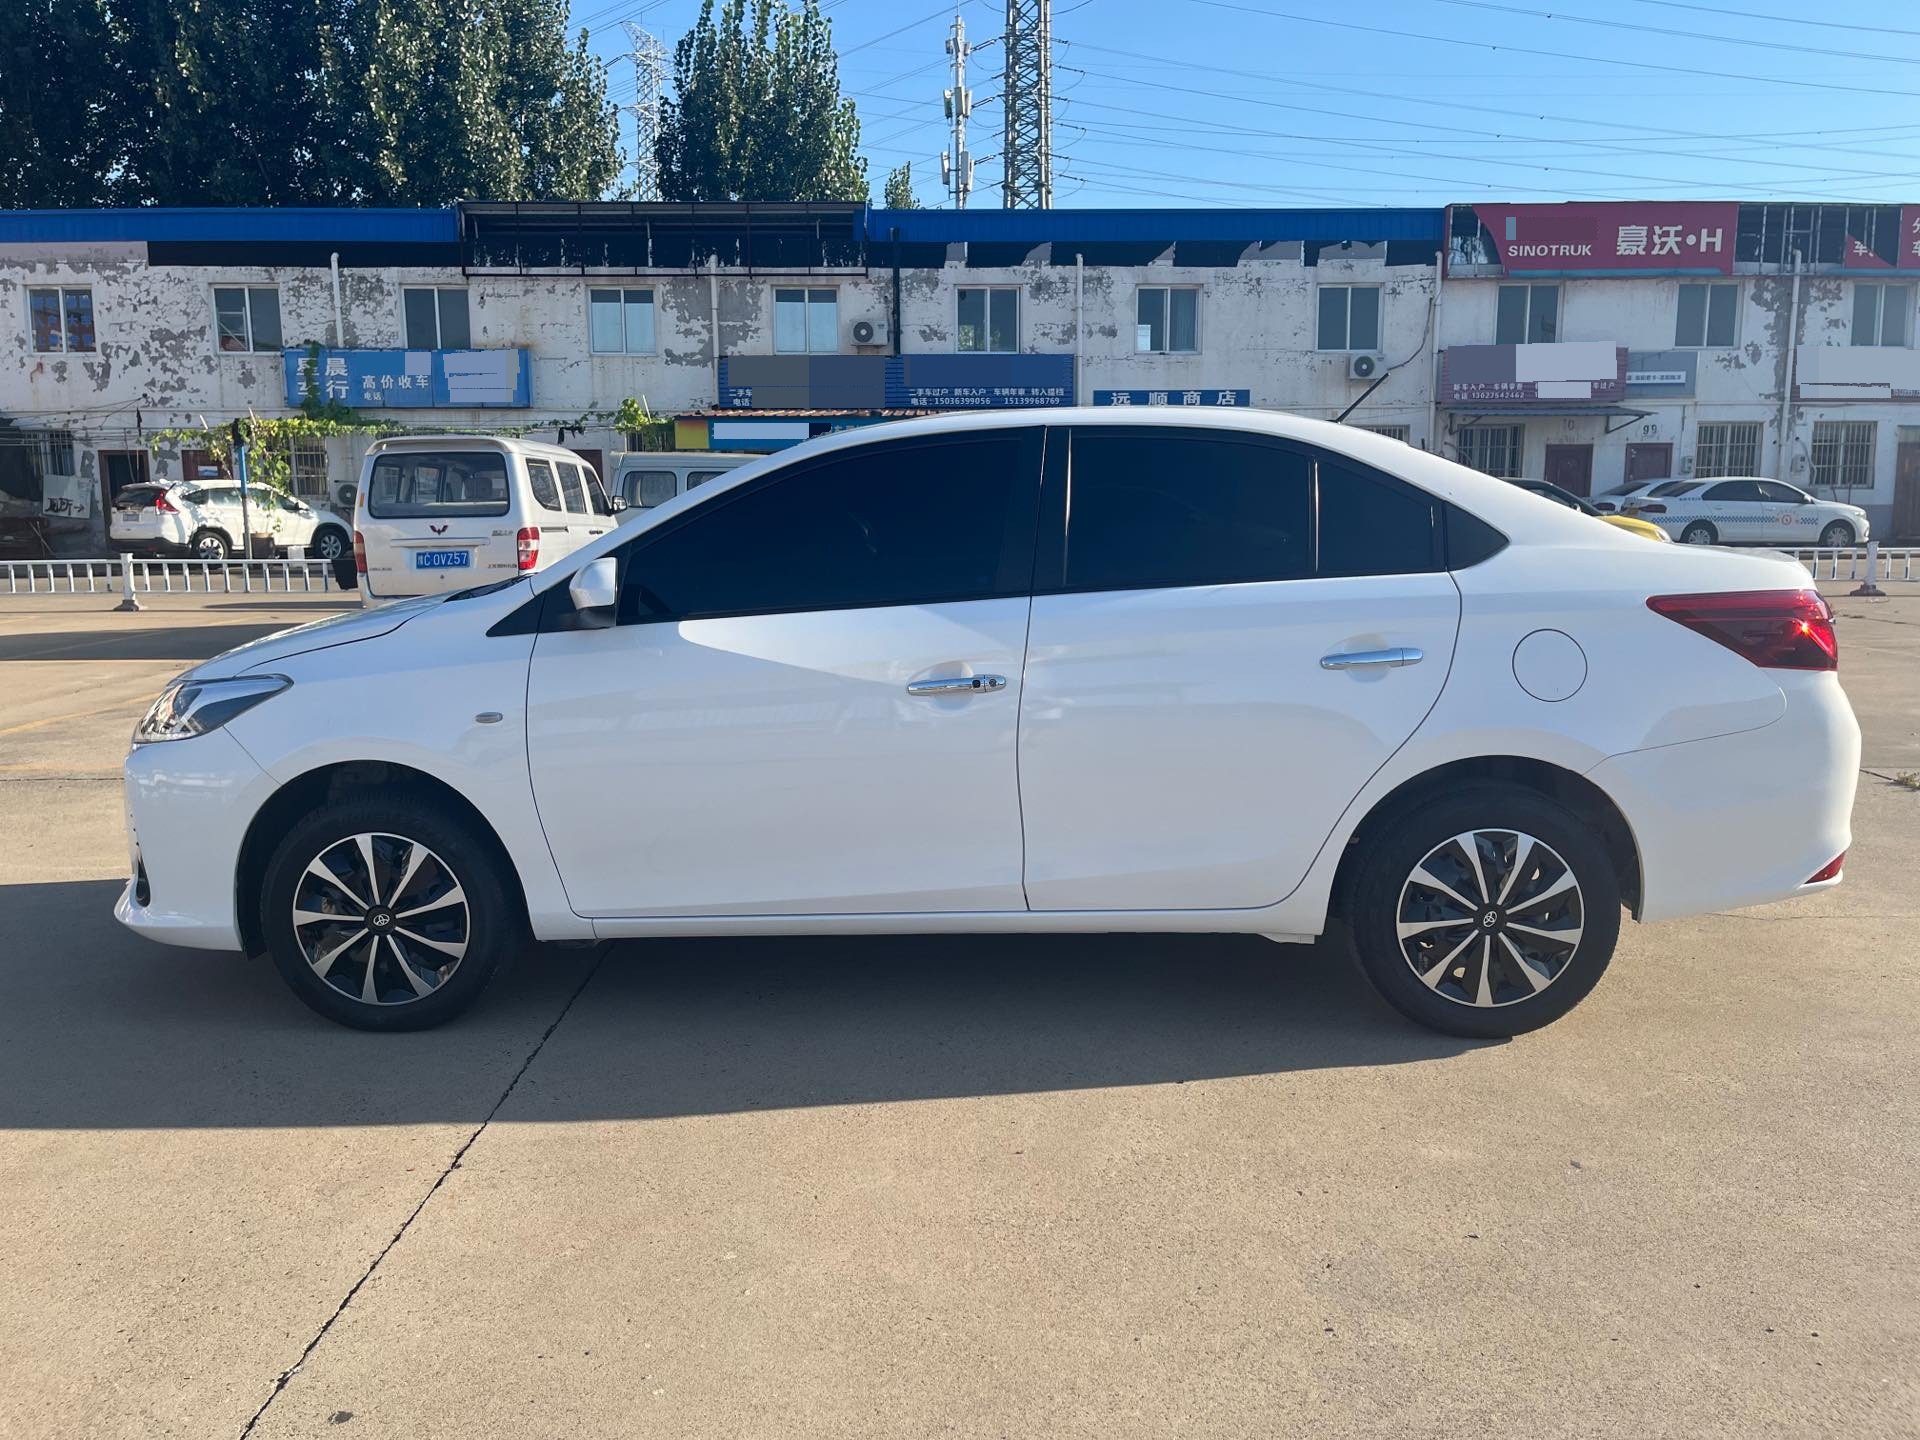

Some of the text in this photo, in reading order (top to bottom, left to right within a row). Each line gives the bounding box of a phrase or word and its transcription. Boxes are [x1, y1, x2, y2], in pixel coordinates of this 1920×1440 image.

[1507, 244, 1592, 257] SINOTRUK
[362, 374, 429, 389] 高价收车
[1111, 391, 1236, 406] 远顺商店
